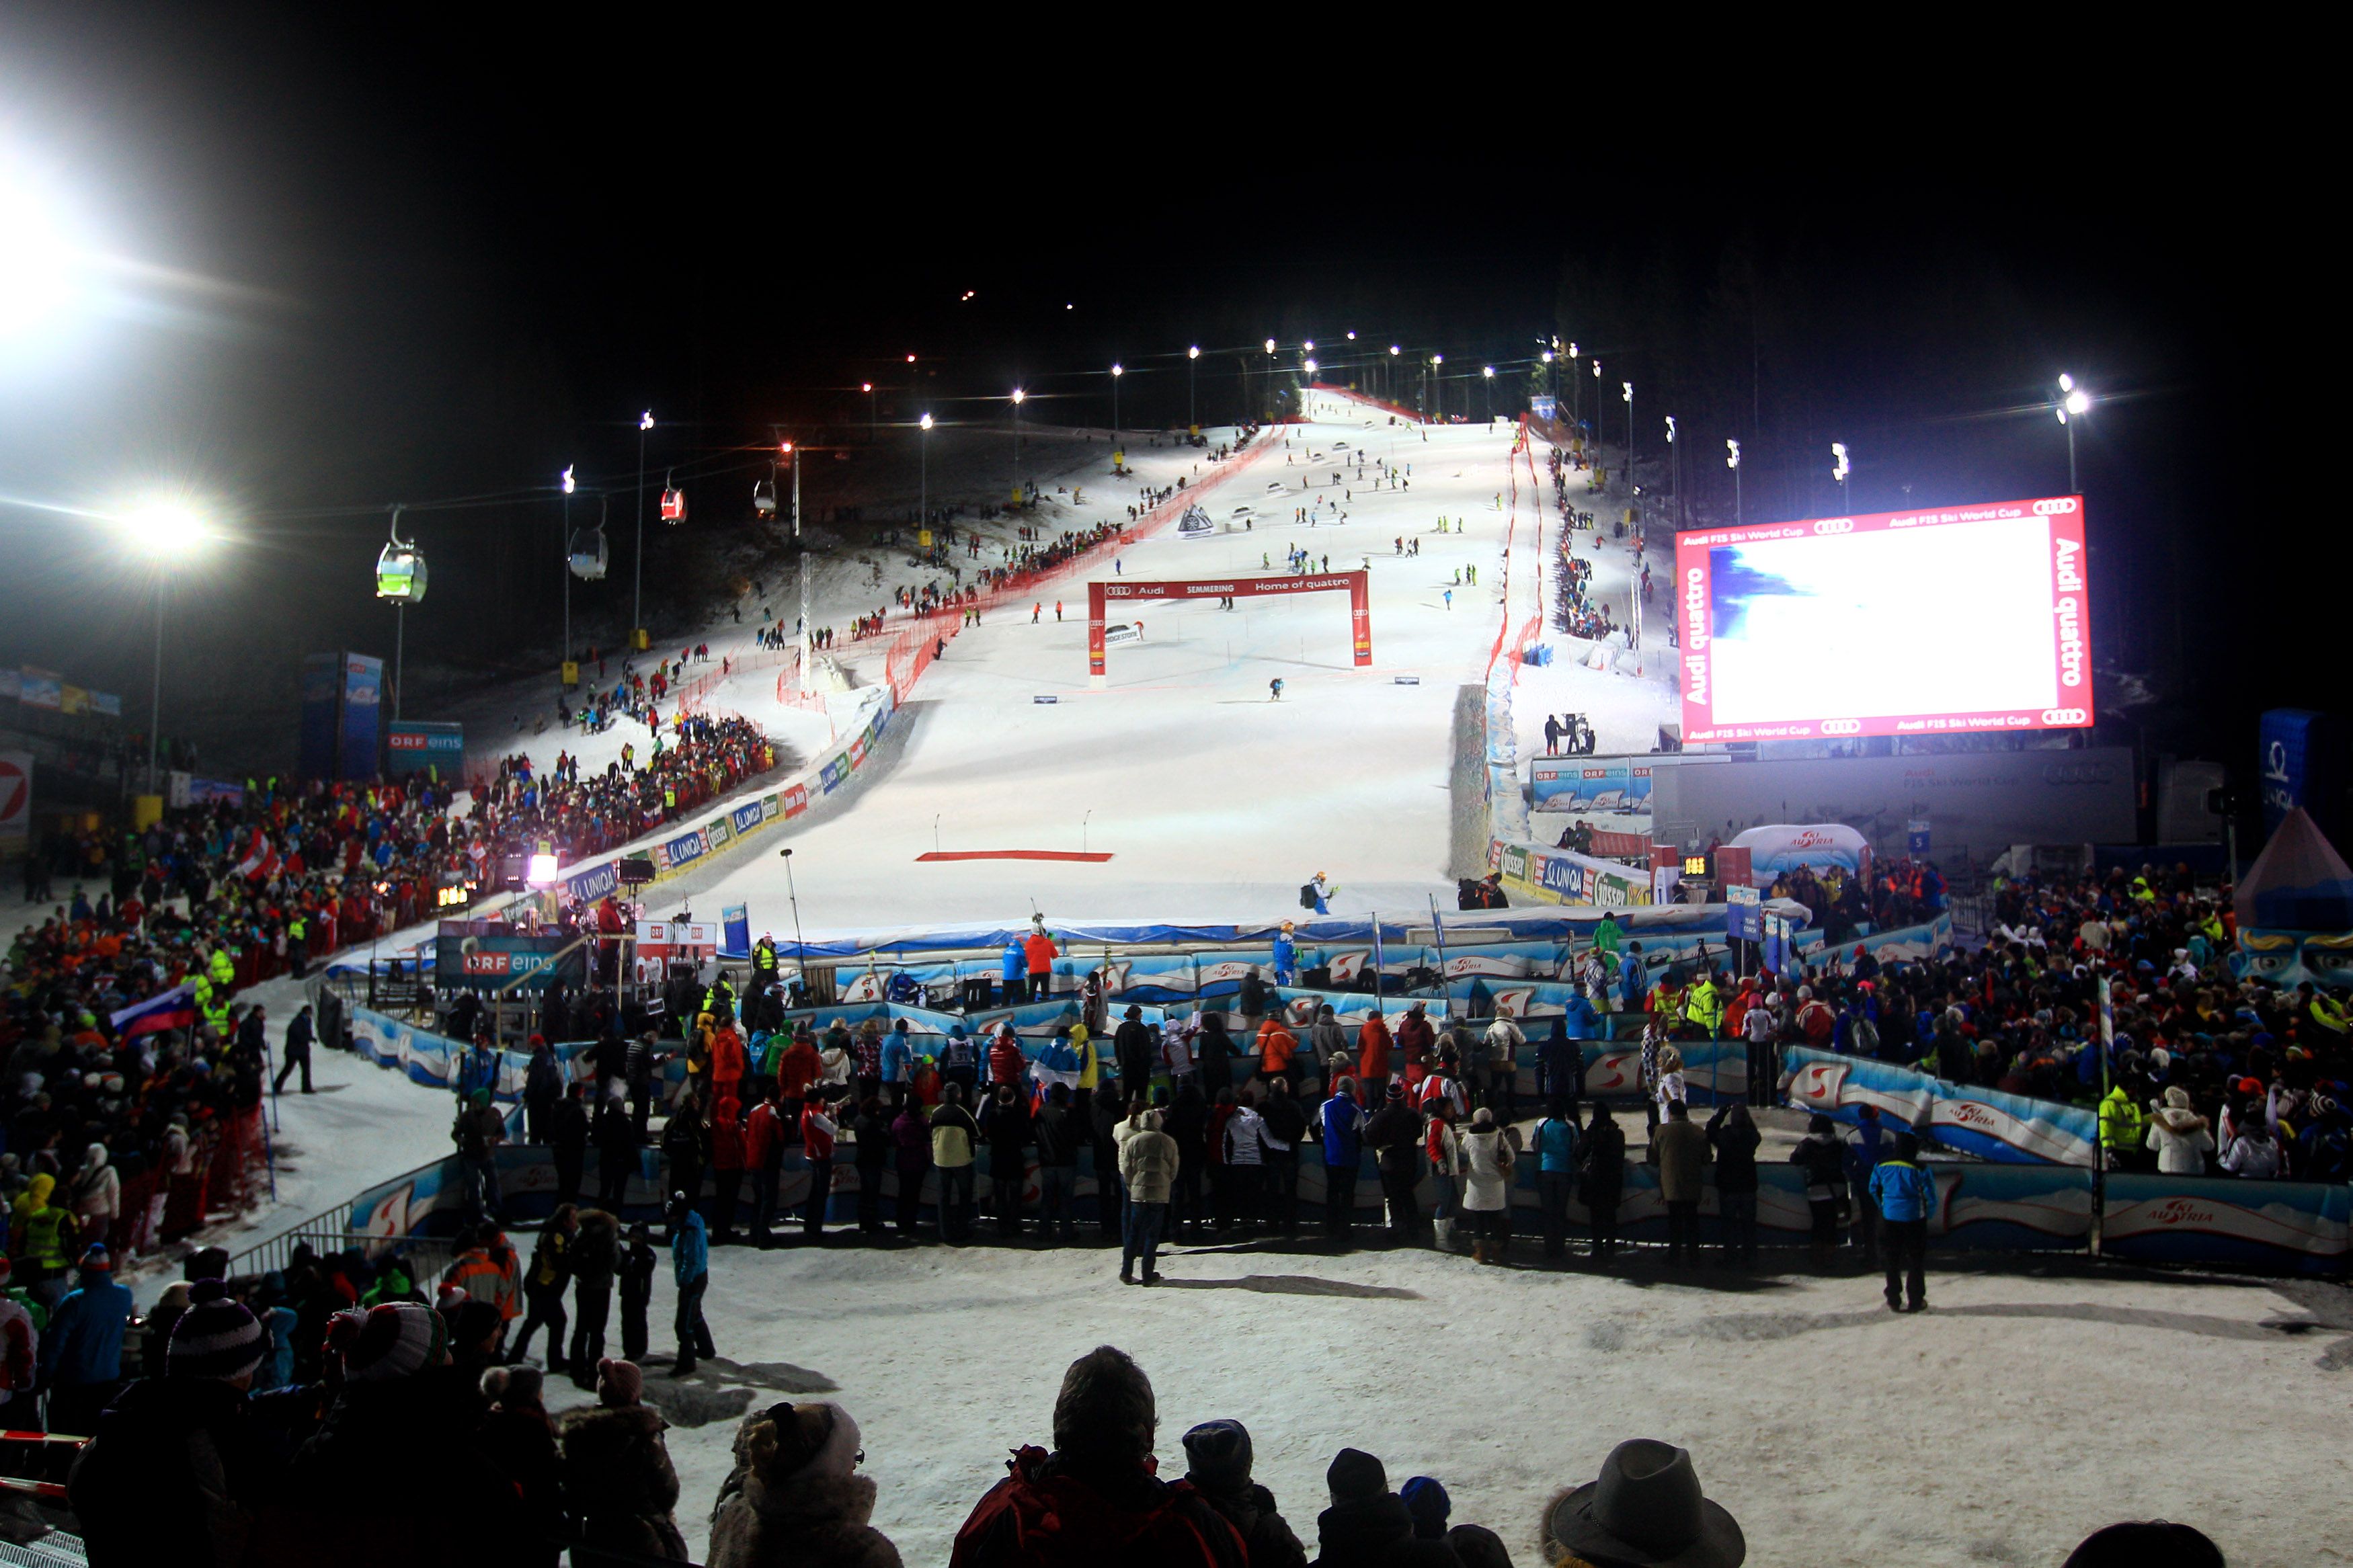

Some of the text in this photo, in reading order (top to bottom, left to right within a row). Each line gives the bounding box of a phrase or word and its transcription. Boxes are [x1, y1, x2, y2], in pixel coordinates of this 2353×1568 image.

[1889, 508, 2022, 528] Audi FIS Ski World Cup
[1683, 528, 1804, 546] Audi FIS Ski World Cup
[1187, 584, 1234, 594] SEMMERING
[1255, 578, 1349, 591] Home of quattro
[2053, 538, 2083, 687] Audi quattro
[1685, 568, 1710, 706] Audi quattro
[1897, 716, 2030, 731] Audi FIS Ski World Cup
[1689, 725, 1811, 739] Audi FIS Ski World Cup
[391, 736, 461, 749] ORF eins
[744, 807, 760, 826] UNIQA
[680, 837, 701, 862] UNIQA
[1791, 837, 1833, 848] AUSTRIA
[584, 871, 614, 897] UNIQA
[1556, 866, 1581, 893] UNIQA
[651, 927, 662, 937] ORF
[467, 955, 553, 971] ORF eins
[1949, 1109, 1995, 1126] AUSTRIA
[2147, 1210, 2213, 1224] AUSTRIA
